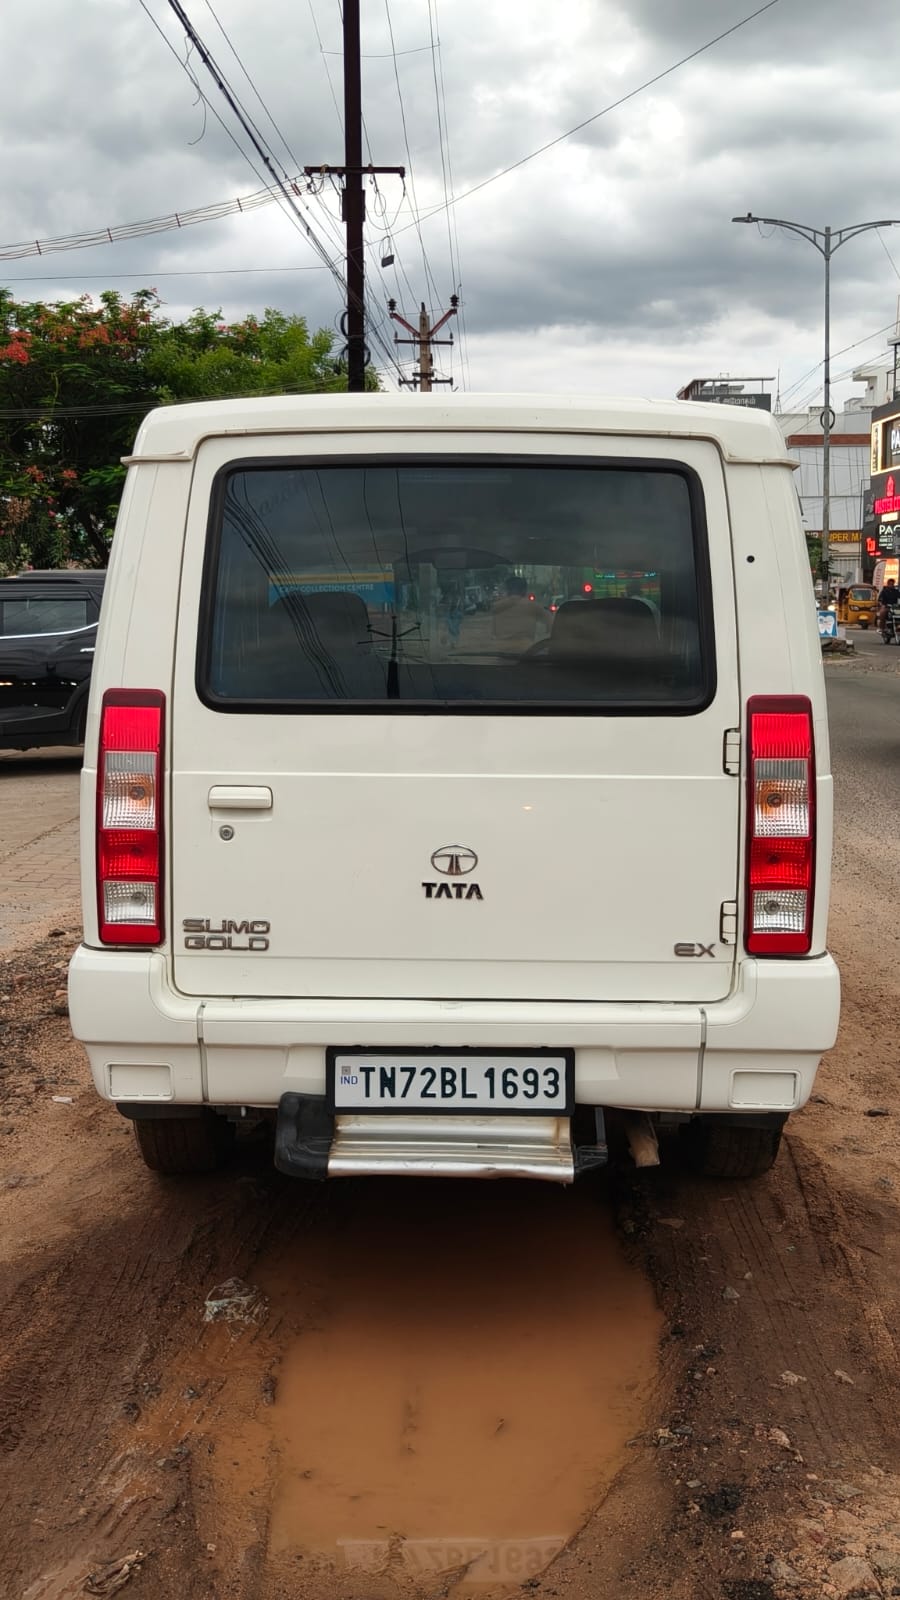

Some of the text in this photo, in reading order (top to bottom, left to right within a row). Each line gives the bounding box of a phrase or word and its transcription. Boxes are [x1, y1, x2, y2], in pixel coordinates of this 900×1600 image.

[421, 882, 484, 900] TATA
[182, 918, 270, 934] SUMO
[184, 935, 270, 951] GOLD
[674, 942, 716, 958] EX
[340, 1066, 561, 1099] IND TN72BL1693
